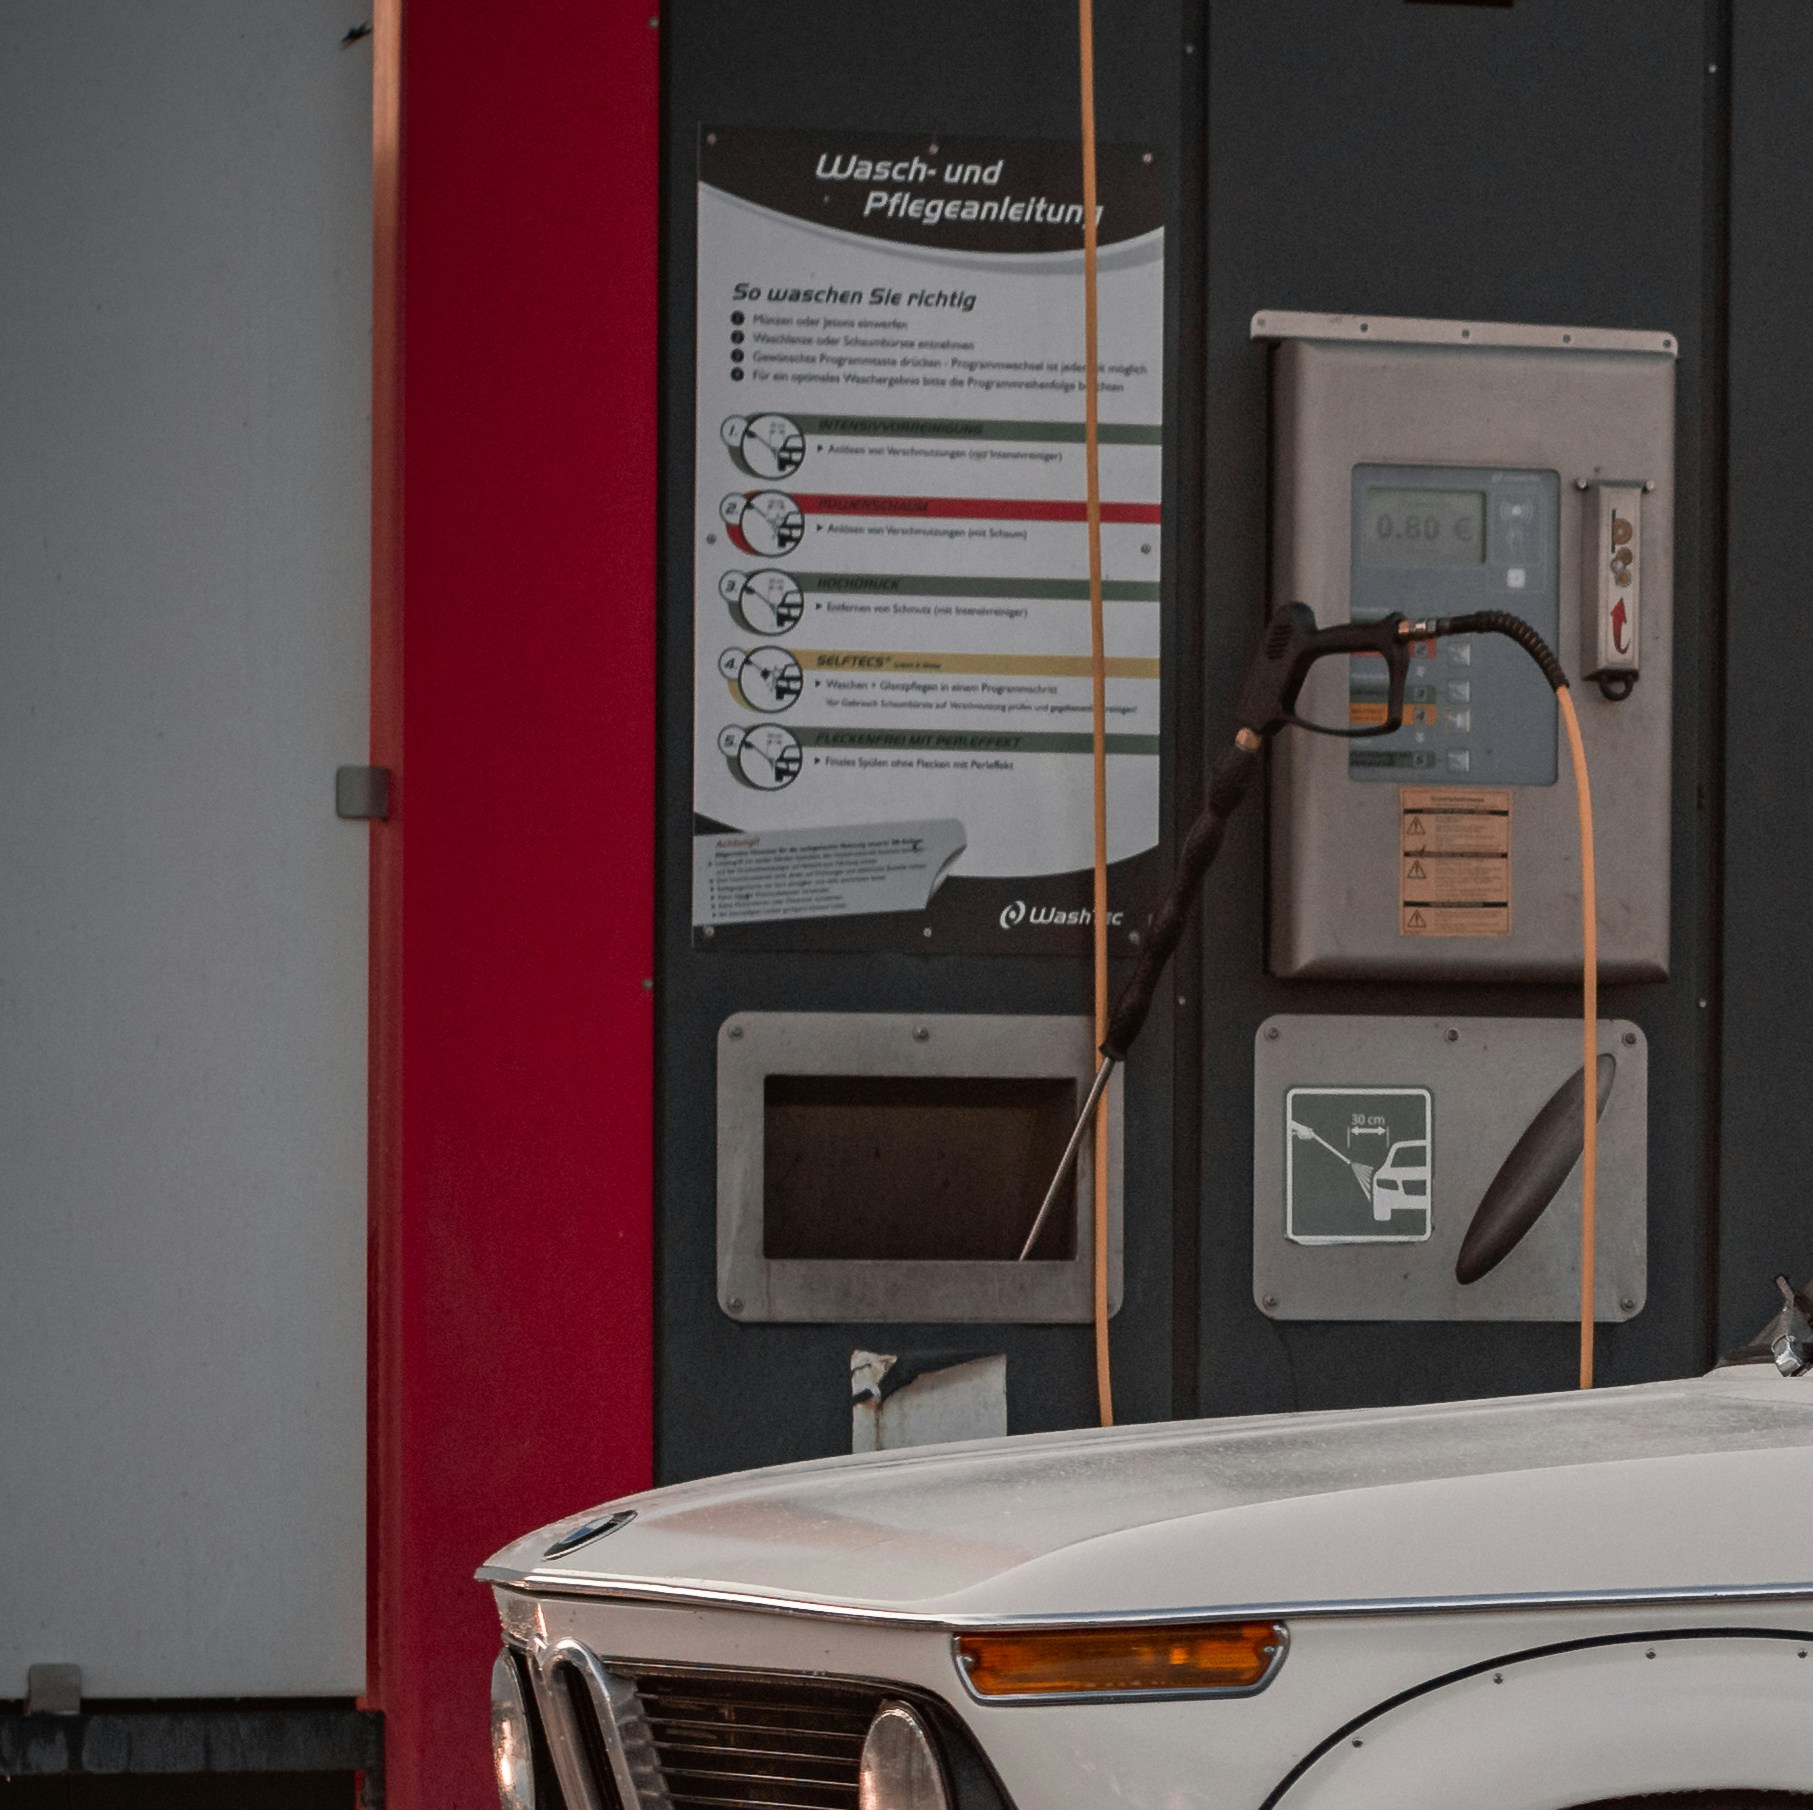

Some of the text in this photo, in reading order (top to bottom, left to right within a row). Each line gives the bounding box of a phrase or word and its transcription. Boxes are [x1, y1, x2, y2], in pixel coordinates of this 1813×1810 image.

[814, 152, 1004, 187] Wasch- und
[732, 282, 977, 312] So waschen Sie richtig
[1029, 906, 1123, 925] Washc
[1351, 1113, 1386, 1126] 30 cm
